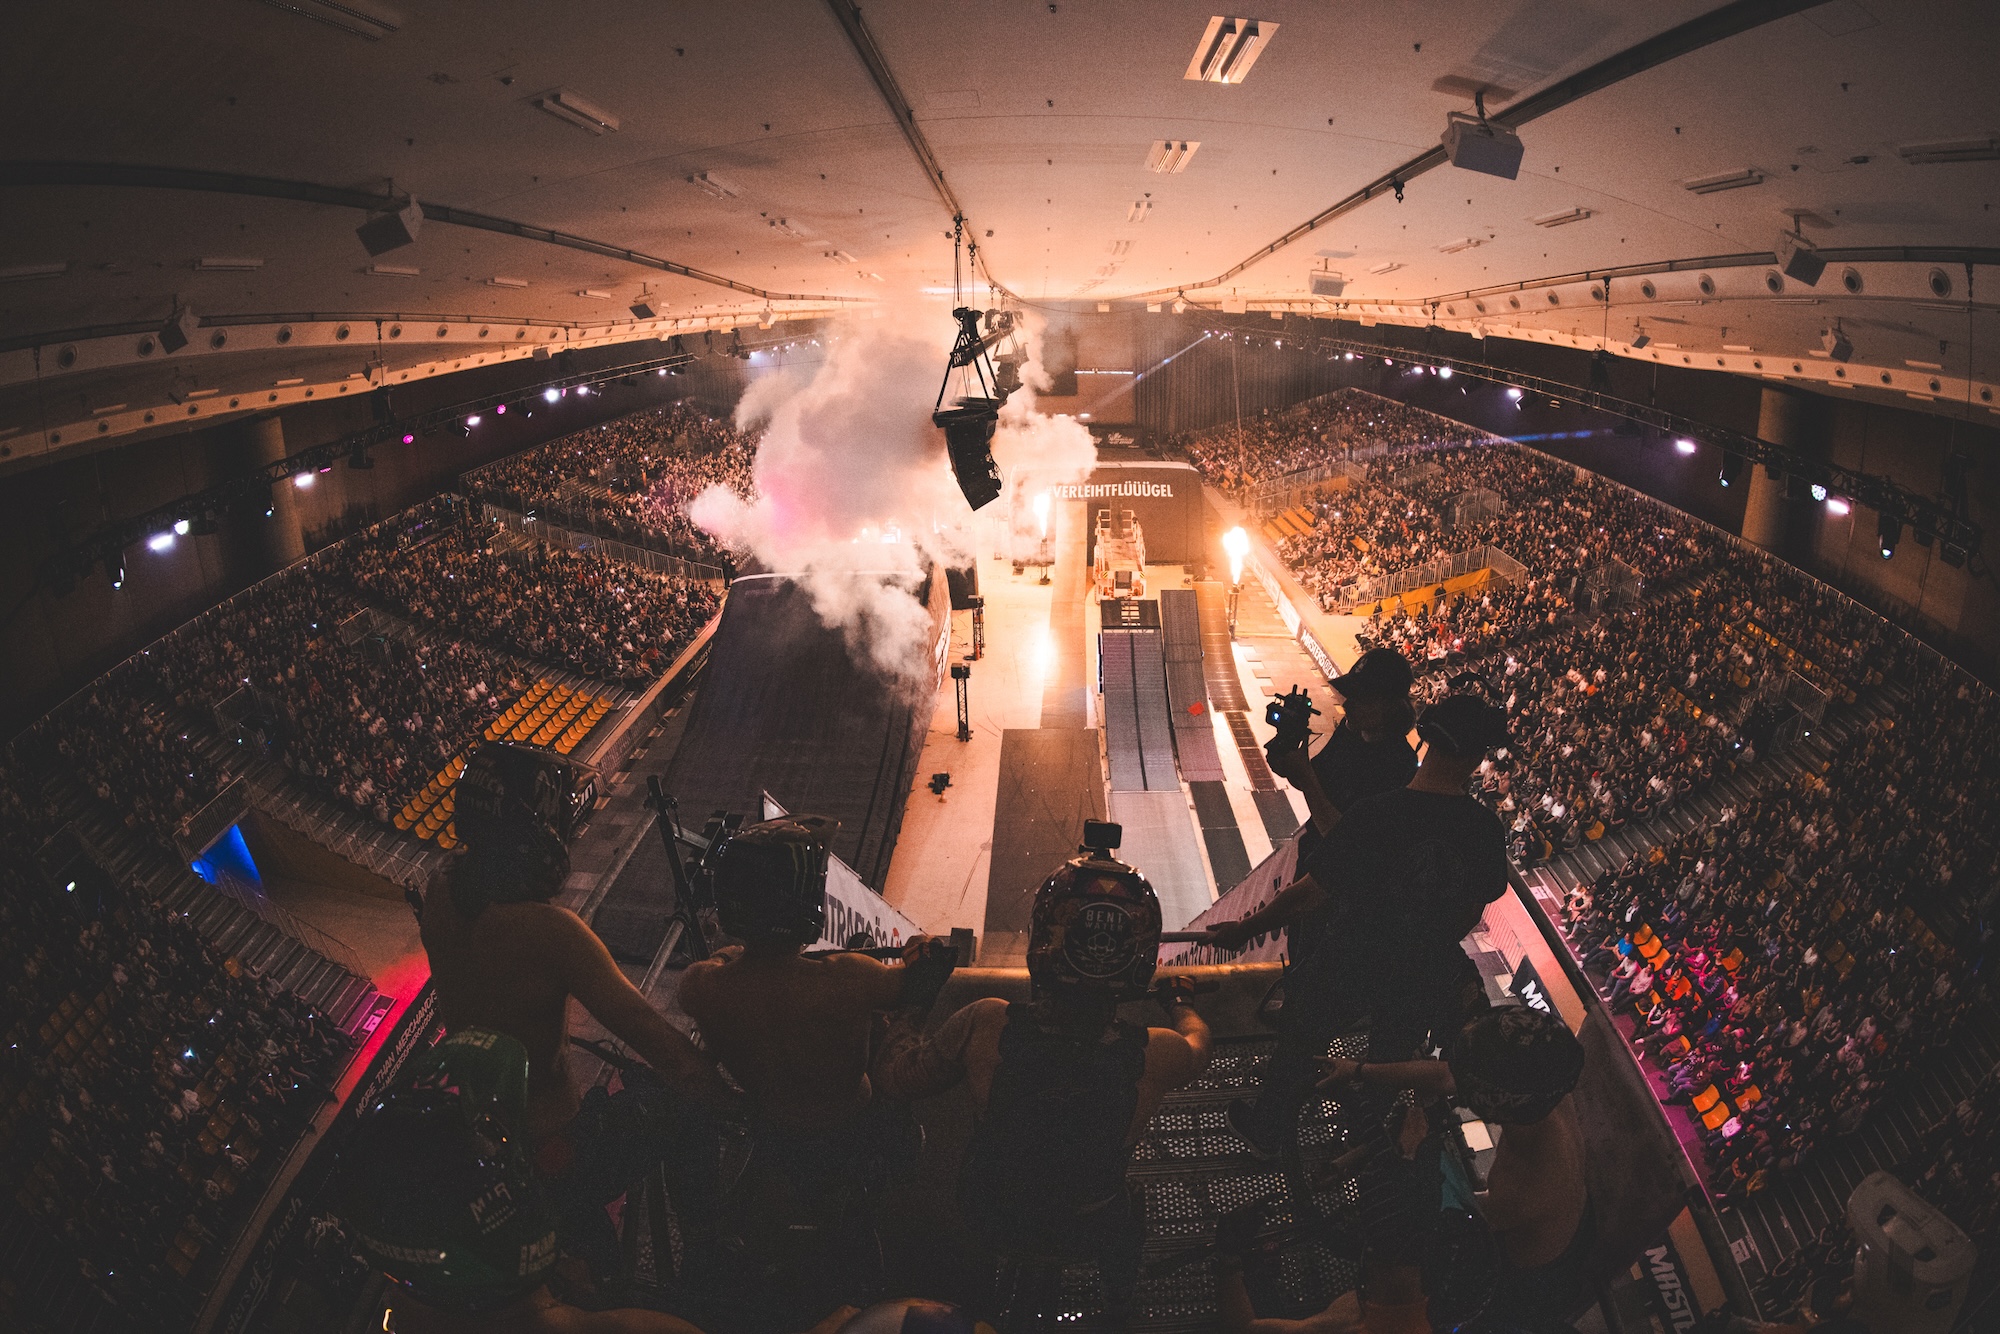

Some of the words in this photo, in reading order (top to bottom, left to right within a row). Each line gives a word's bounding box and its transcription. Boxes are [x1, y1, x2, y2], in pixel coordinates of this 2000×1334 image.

[1085, 909, 1124, 923] BENT
[1084, 921, 1125, 933] WATER
[355, 1081, 378, 1119] MORE
[374, 1051, 397, 1083] THAN
